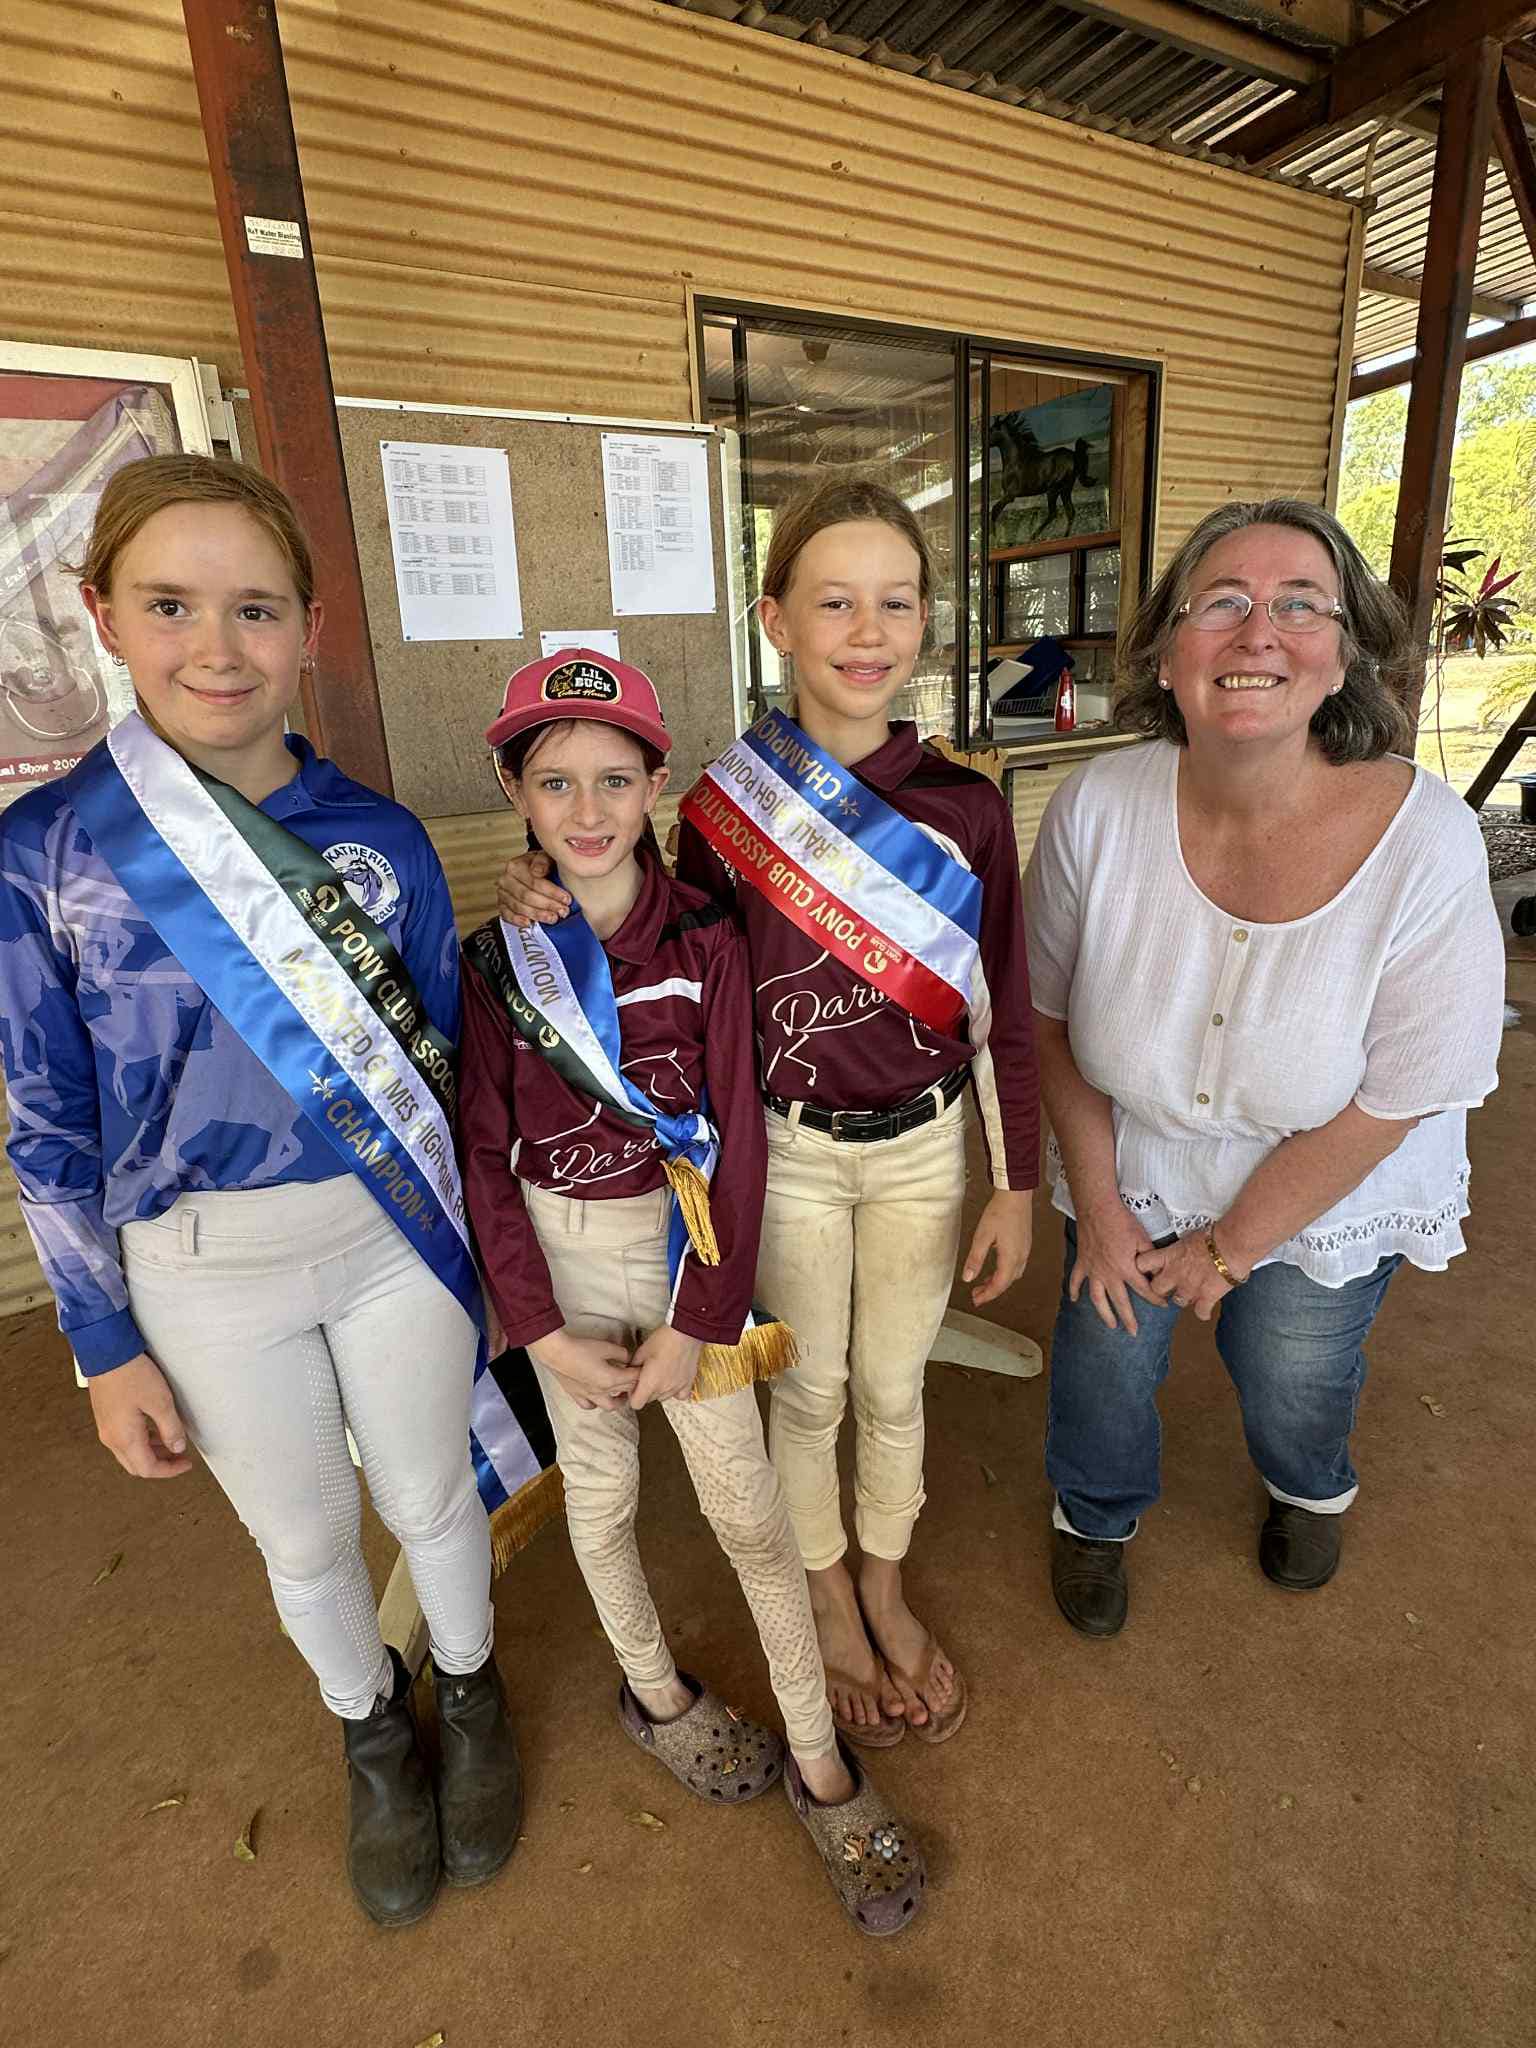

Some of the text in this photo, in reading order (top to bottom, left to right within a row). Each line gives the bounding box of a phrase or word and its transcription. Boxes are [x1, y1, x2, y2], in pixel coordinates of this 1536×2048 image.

[574, 677, 611, 693] BUCK
[581, 667, 603, 681] LIL
[717, 747, 757, 795] POINT
[750, 716, 842, 801] CHAMPIO
[325, 846, 395, 881] KATHERINE
[767, 862, 815, 908] CLUB
[808, 901, 868, 951] PONY
[330, 918, 390, 982] PONY
[377, 979, 417, 1034] CLUB
[363, 1053, 420, 1122] GAMES
[409, 1115, 446, 1166] HIGH
[326, 1098, 426, 1218] CHAMPION
